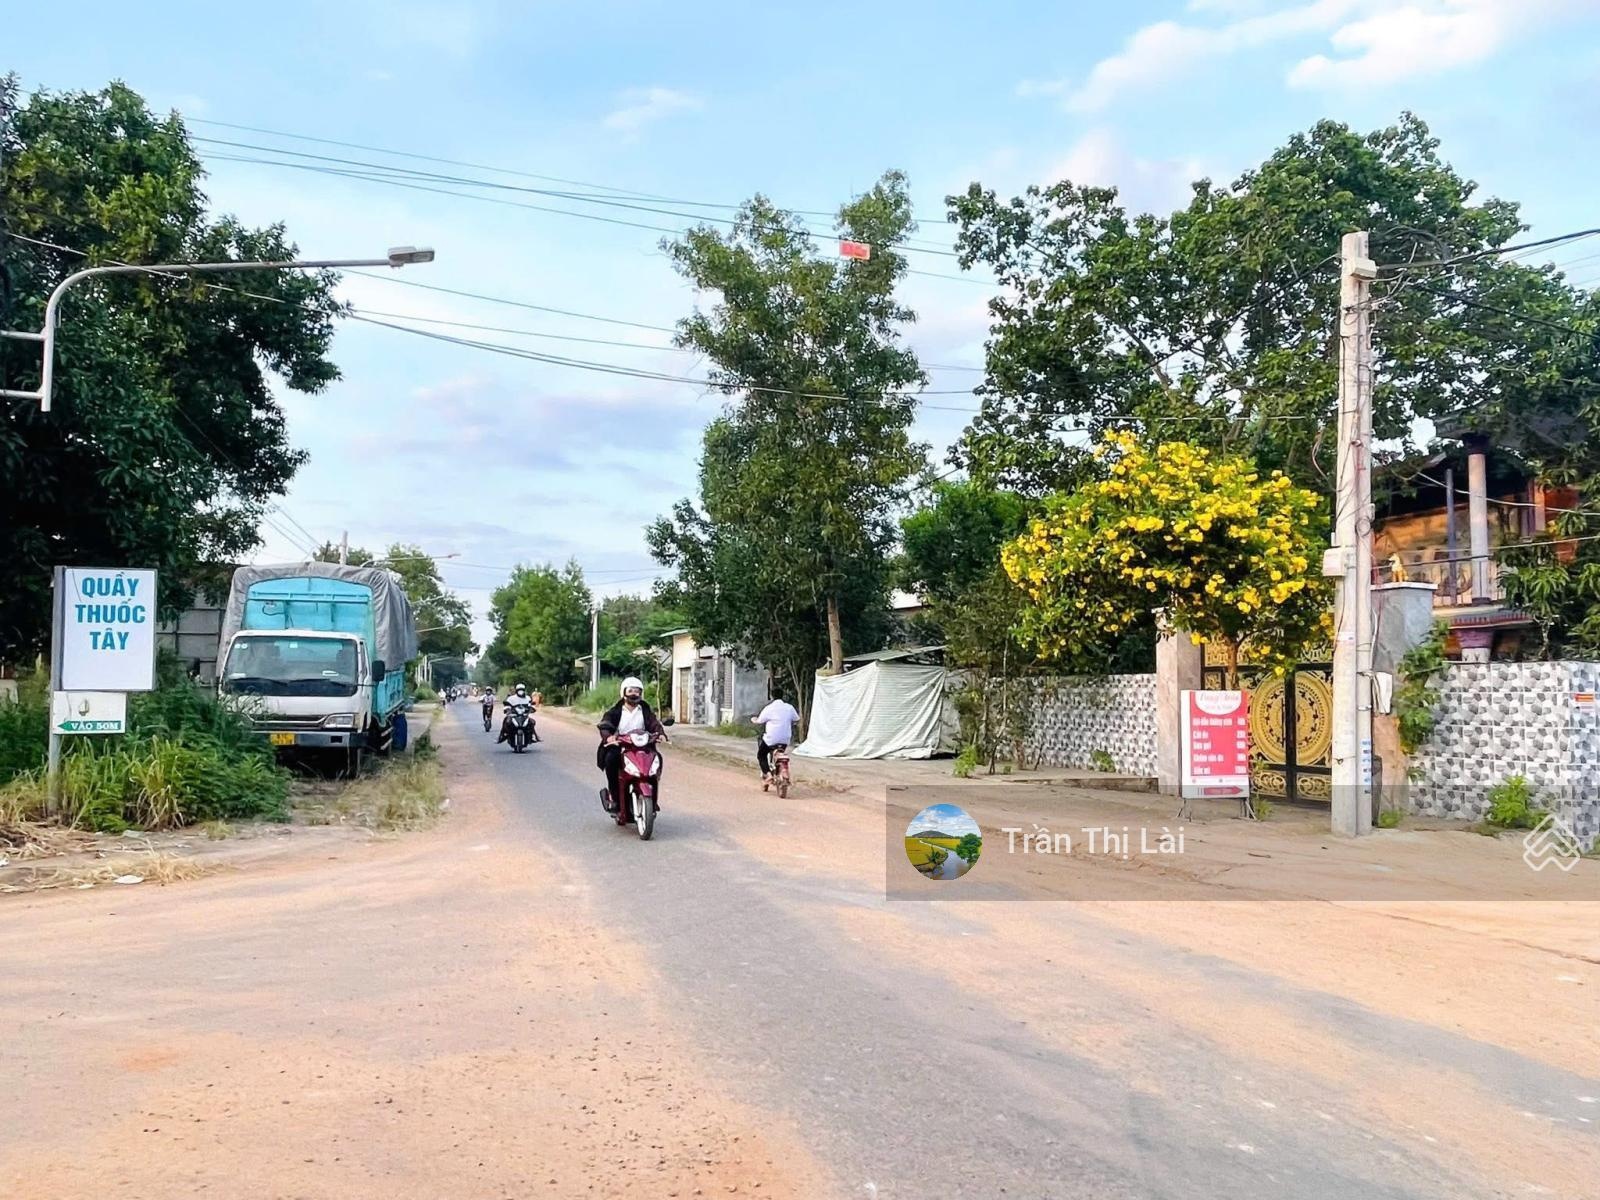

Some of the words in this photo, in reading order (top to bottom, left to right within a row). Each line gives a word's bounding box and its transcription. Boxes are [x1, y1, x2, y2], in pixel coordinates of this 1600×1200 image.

[81, 571, 140, 598] QUẦY
[75, 598, 146, 624] THUỐC
[89, 628, 130, 650] TÂY
